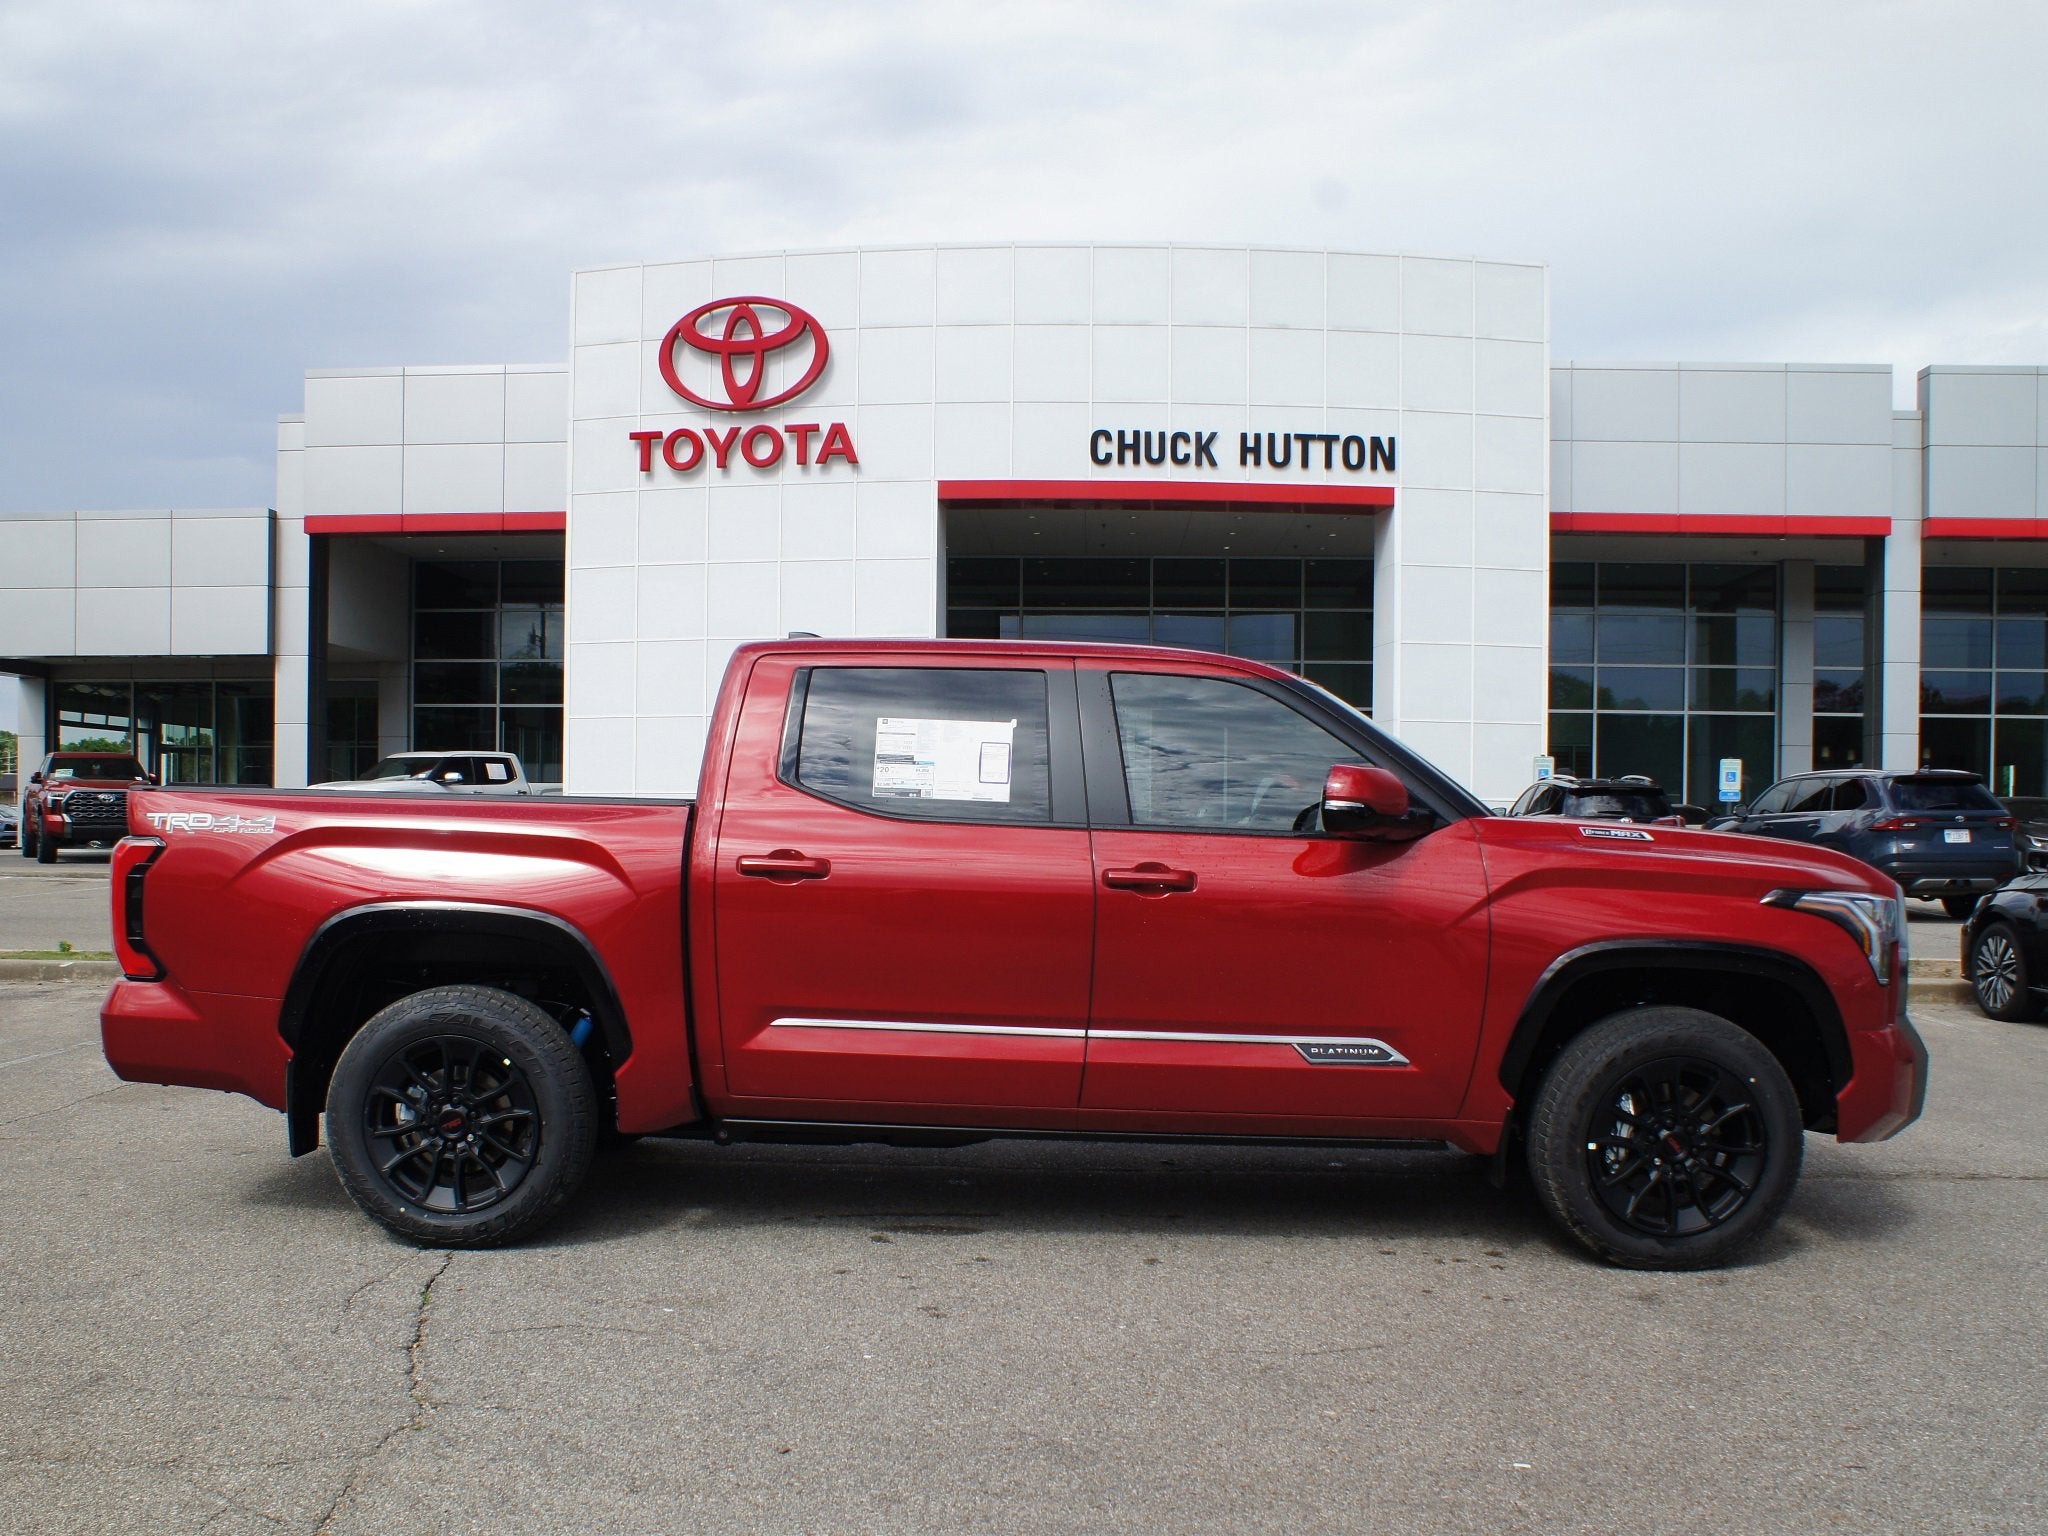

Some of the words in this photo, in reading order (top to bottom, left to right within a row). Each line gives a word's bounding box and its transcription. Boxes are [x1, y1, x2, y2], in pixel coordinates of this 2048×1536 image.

[629, 422, 859, 472] TOYOTA
[1090, 429, 1218, 467] CHUCK
[1239, 432, 1396, 471] HUTTON
[146, 812, 215, 833] TRD
[1310, 1047, 1379, 1056] PLATINUM
